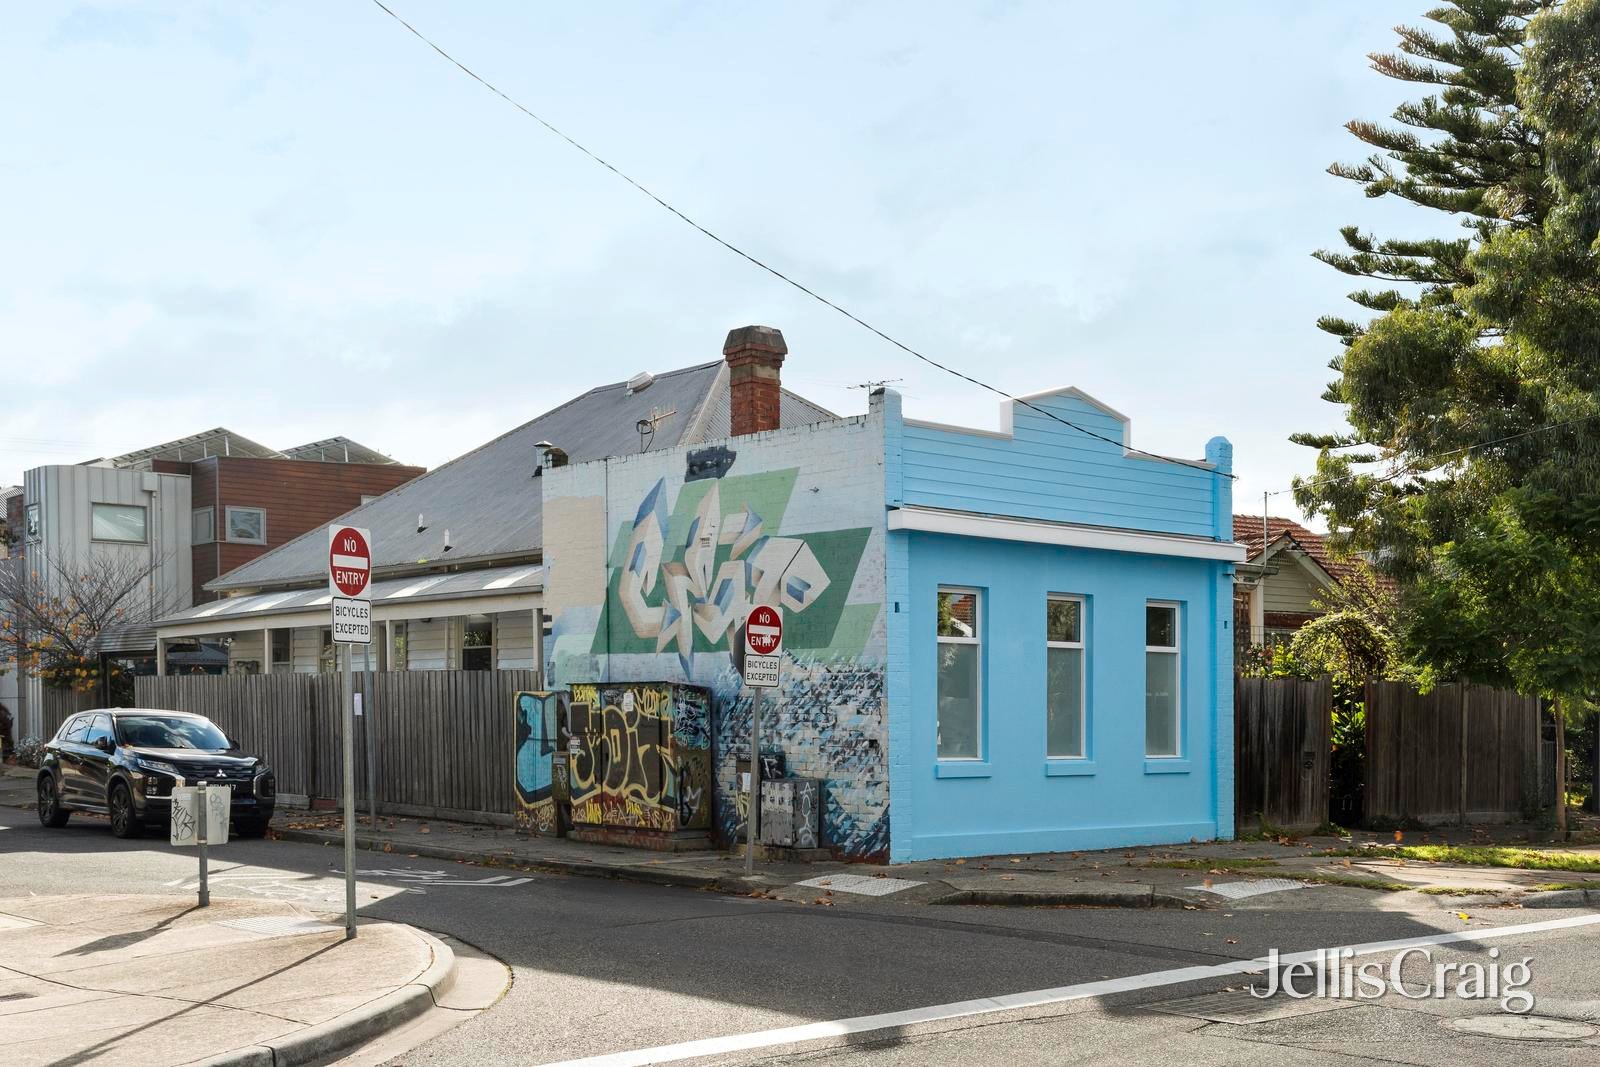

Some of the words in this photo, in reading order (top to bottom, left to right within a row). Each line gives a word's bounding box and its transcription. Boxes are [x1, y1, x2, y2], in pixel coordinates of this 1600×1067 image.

[344, 539, 357, 552] NO
[335, 571, 365, 585] ENTRY
[335, 605, 368, 619] BICYCLES
[759, 613, 770, 624] NO
[335, 622, 368, 635] EXCEPTED
[751, 636, 776, 647] ENY
[747, 660, 777, 669] BICYCLES
[747, 672, 777, 681] EXCEPTED
